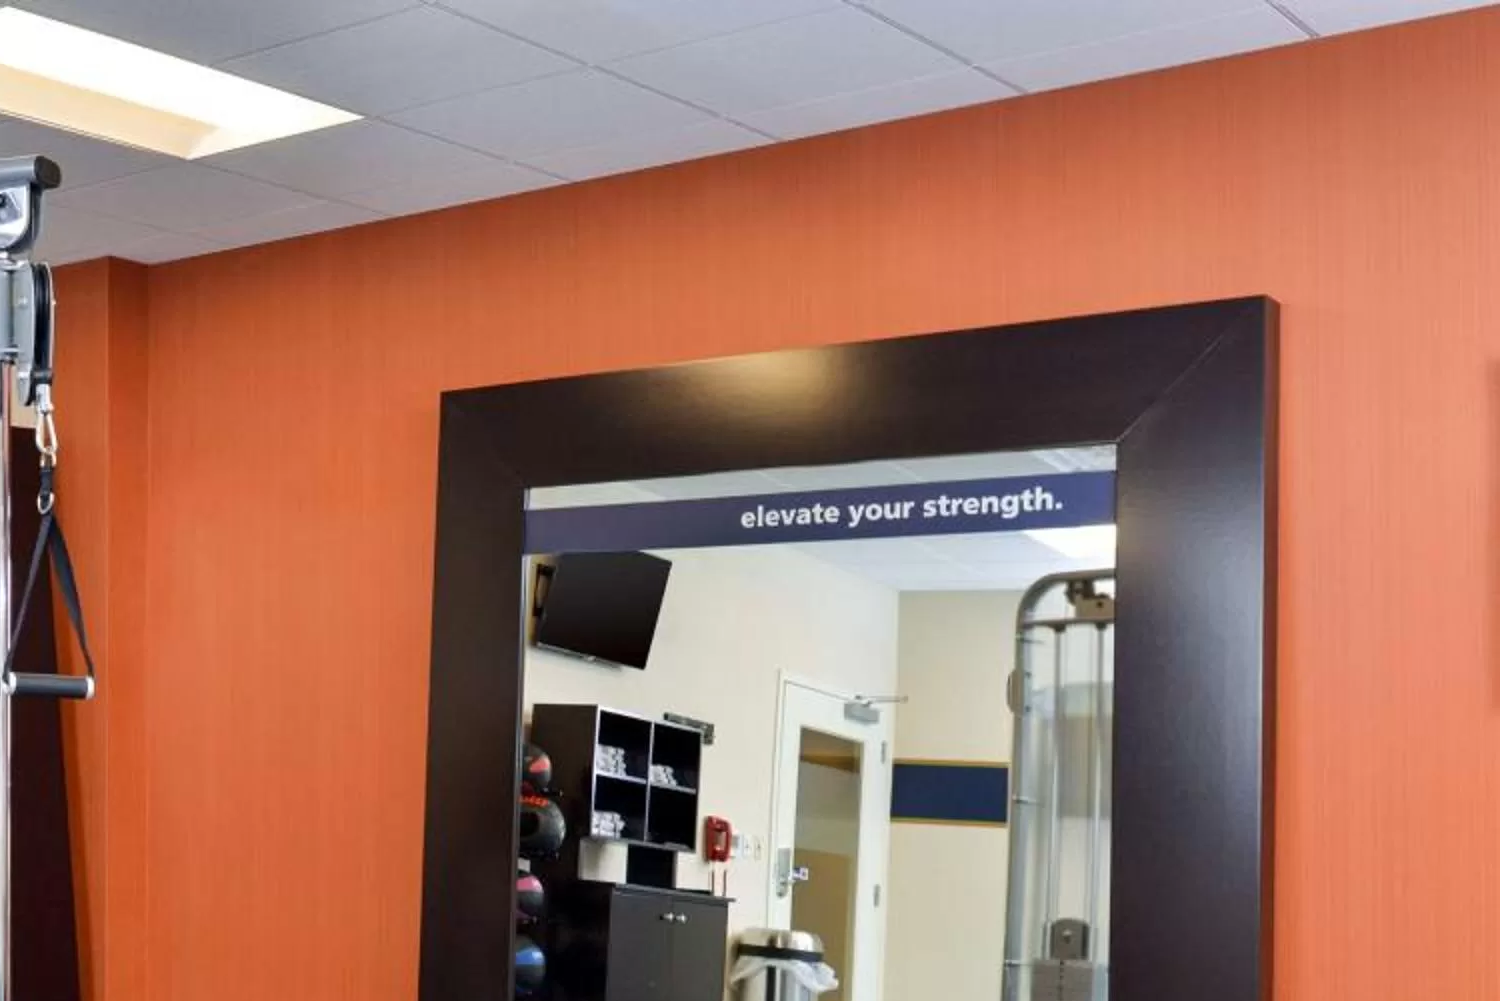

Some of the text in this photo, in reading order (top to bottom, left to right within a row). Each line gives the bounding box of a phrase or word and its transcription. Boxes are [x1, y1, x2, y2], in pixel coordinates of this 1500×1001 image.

[740, 486, 1064, 528] elevate your strength.
